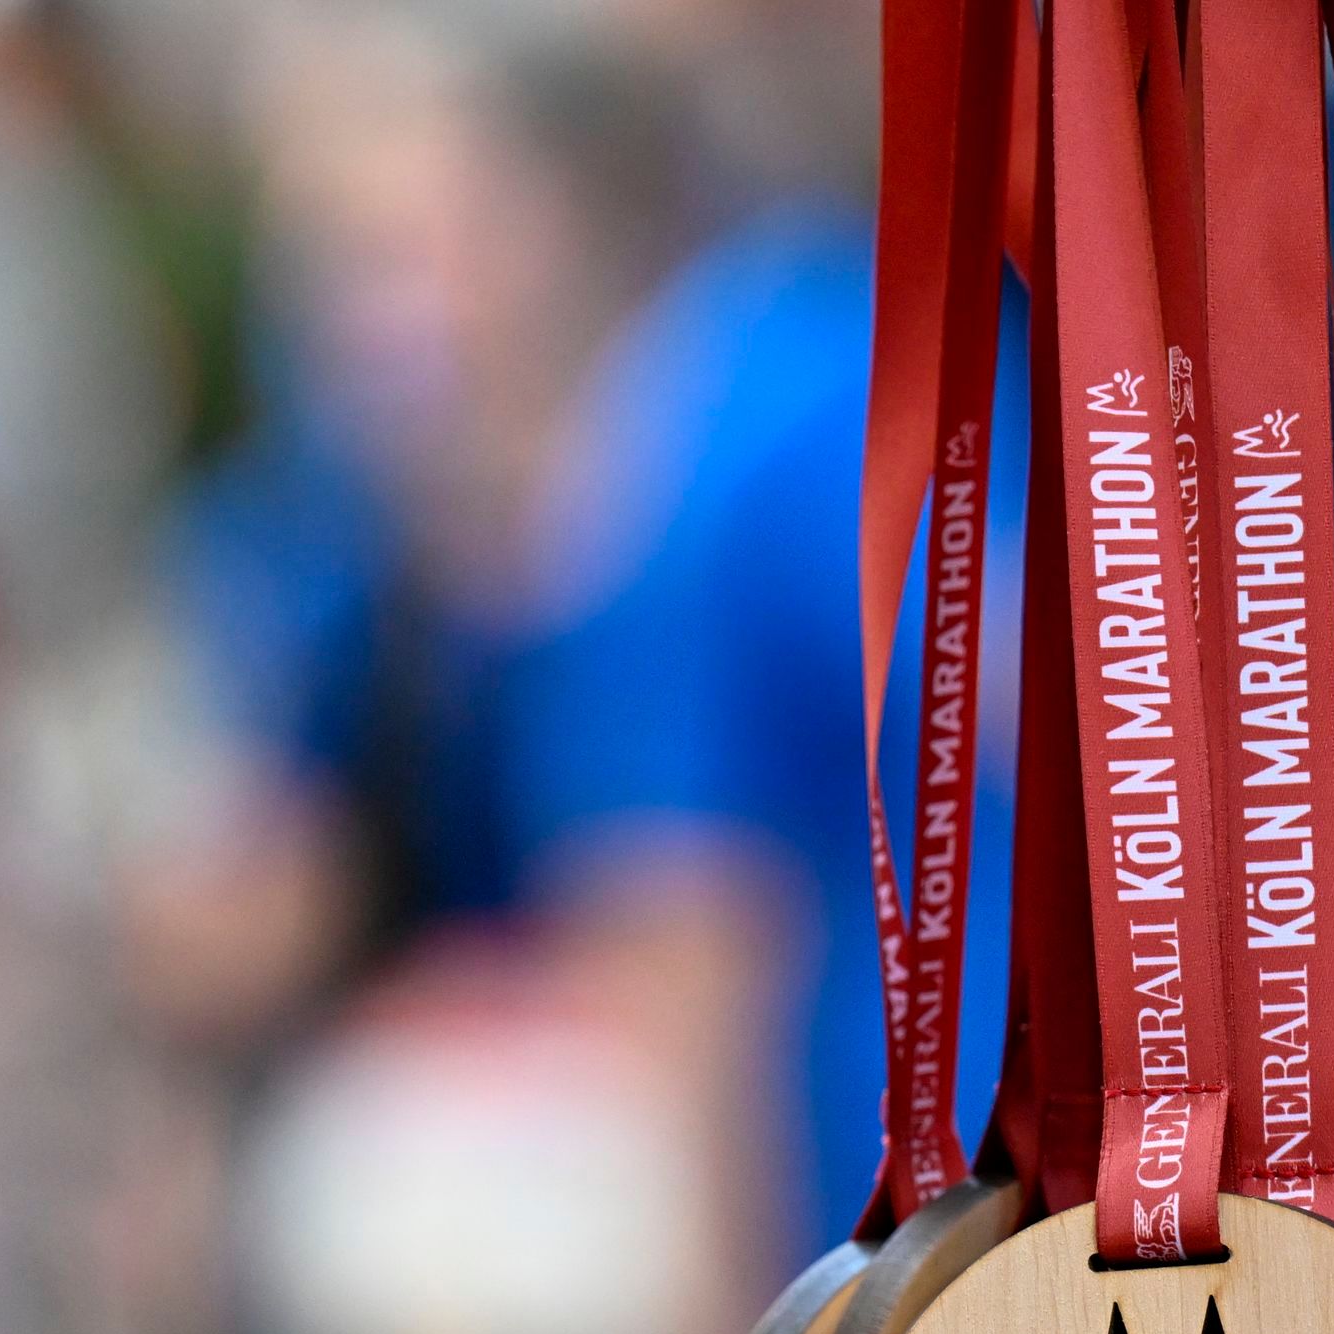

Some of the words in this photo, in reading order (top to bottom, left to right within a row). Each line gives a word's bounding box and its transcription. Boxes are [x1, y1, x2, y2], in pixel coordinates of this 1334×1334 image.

[927, 480, 976, 787] MARATHON
[1089, 431, 1174, 740] MARATHON
[1234, 473, 1311, 786] MARATHON
[917, 800, 959, 942] KÖLN
[1108, 758, 1185, 901] KÖLN
[1243, 804, 1316, 949] KÖLN
[1130, 917, 1191, 1189] GENERALI
[1259, 964, 1315, 1211] ENERALI
